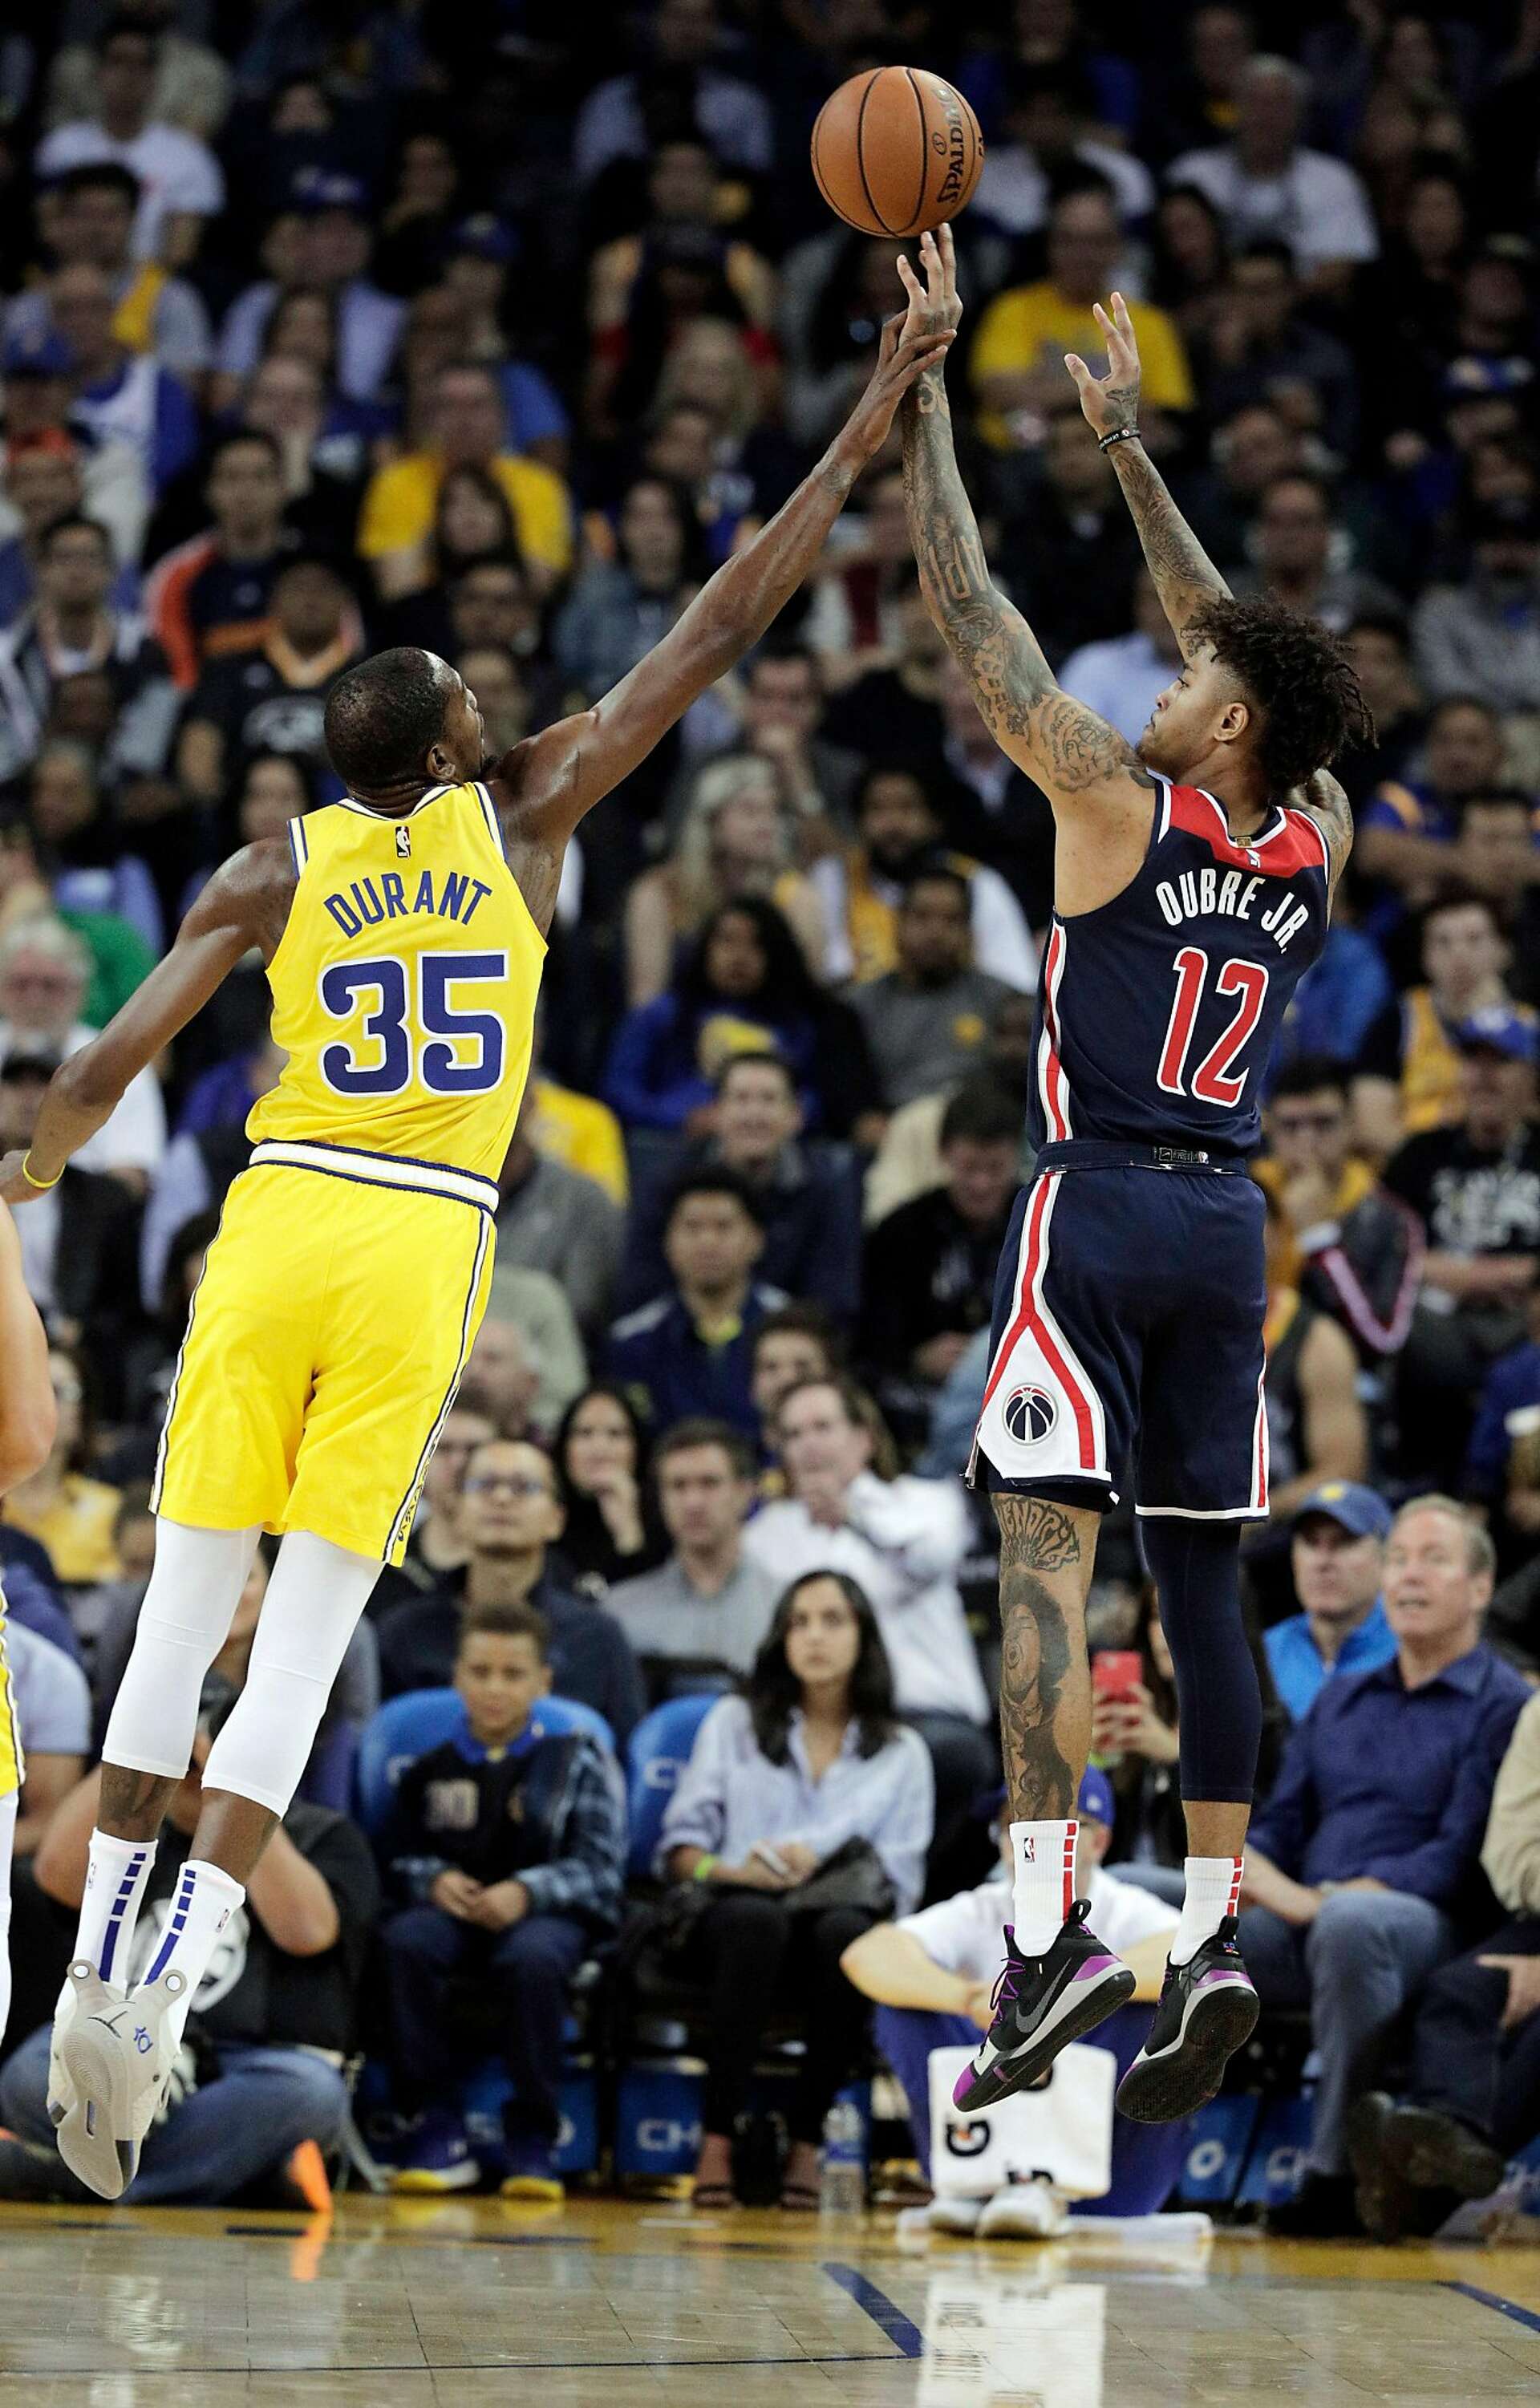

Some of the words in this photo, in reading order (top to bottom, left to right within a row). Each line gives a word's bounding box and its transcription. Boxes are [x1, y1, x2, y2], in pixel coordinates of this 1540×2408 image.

[933, 87, 964, 203] SPALDING
[323, 870, 492, 938] DURANT
[1156, 868, 1266, 926] OUBRE
[318, 950, 509, 1097] 35
[1157, 947, 1269, 1108] 12
